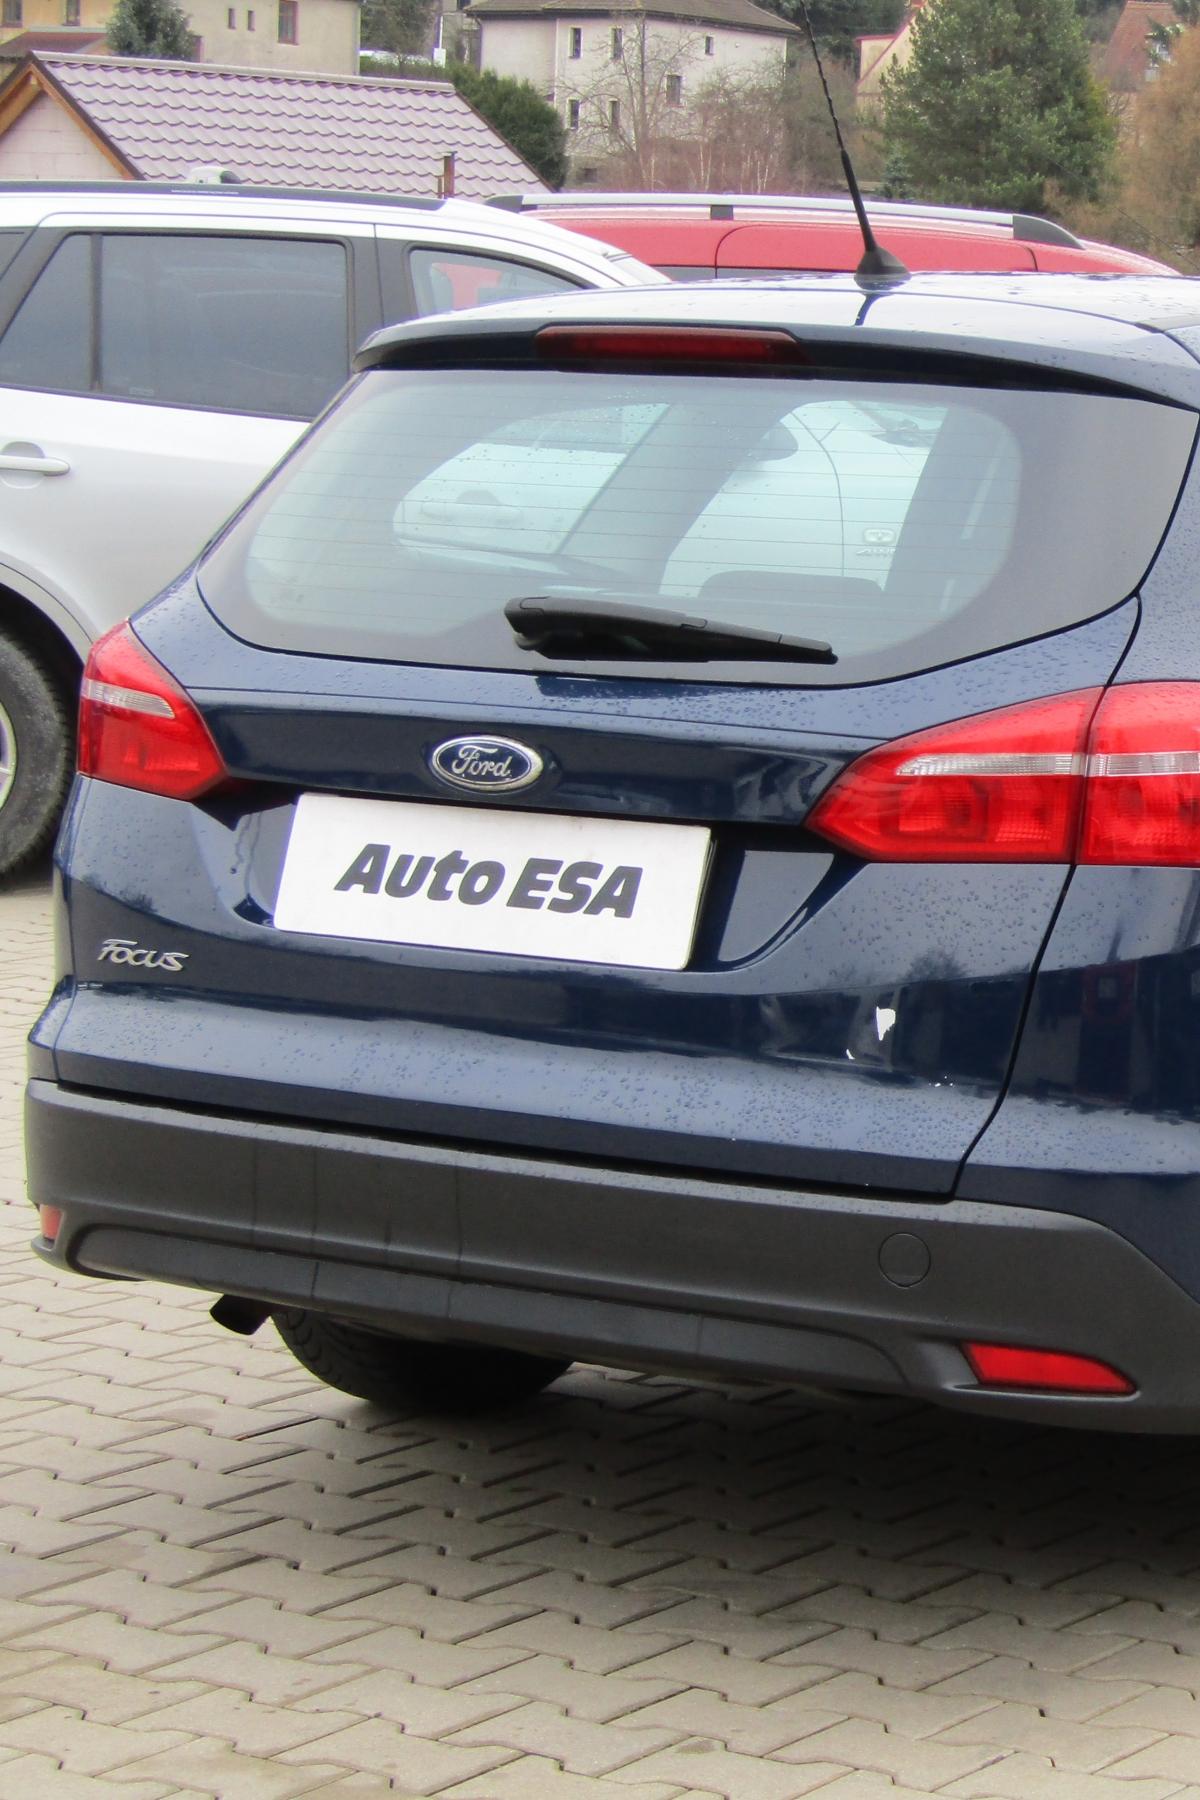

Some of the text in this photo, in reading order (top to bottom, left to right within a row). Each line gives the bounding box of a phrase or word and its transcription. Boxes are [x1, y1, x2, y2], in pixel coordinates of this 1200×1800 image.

[452, 745, 512, 777] Ford
[333, 843, 643, 918] Auto ESA
